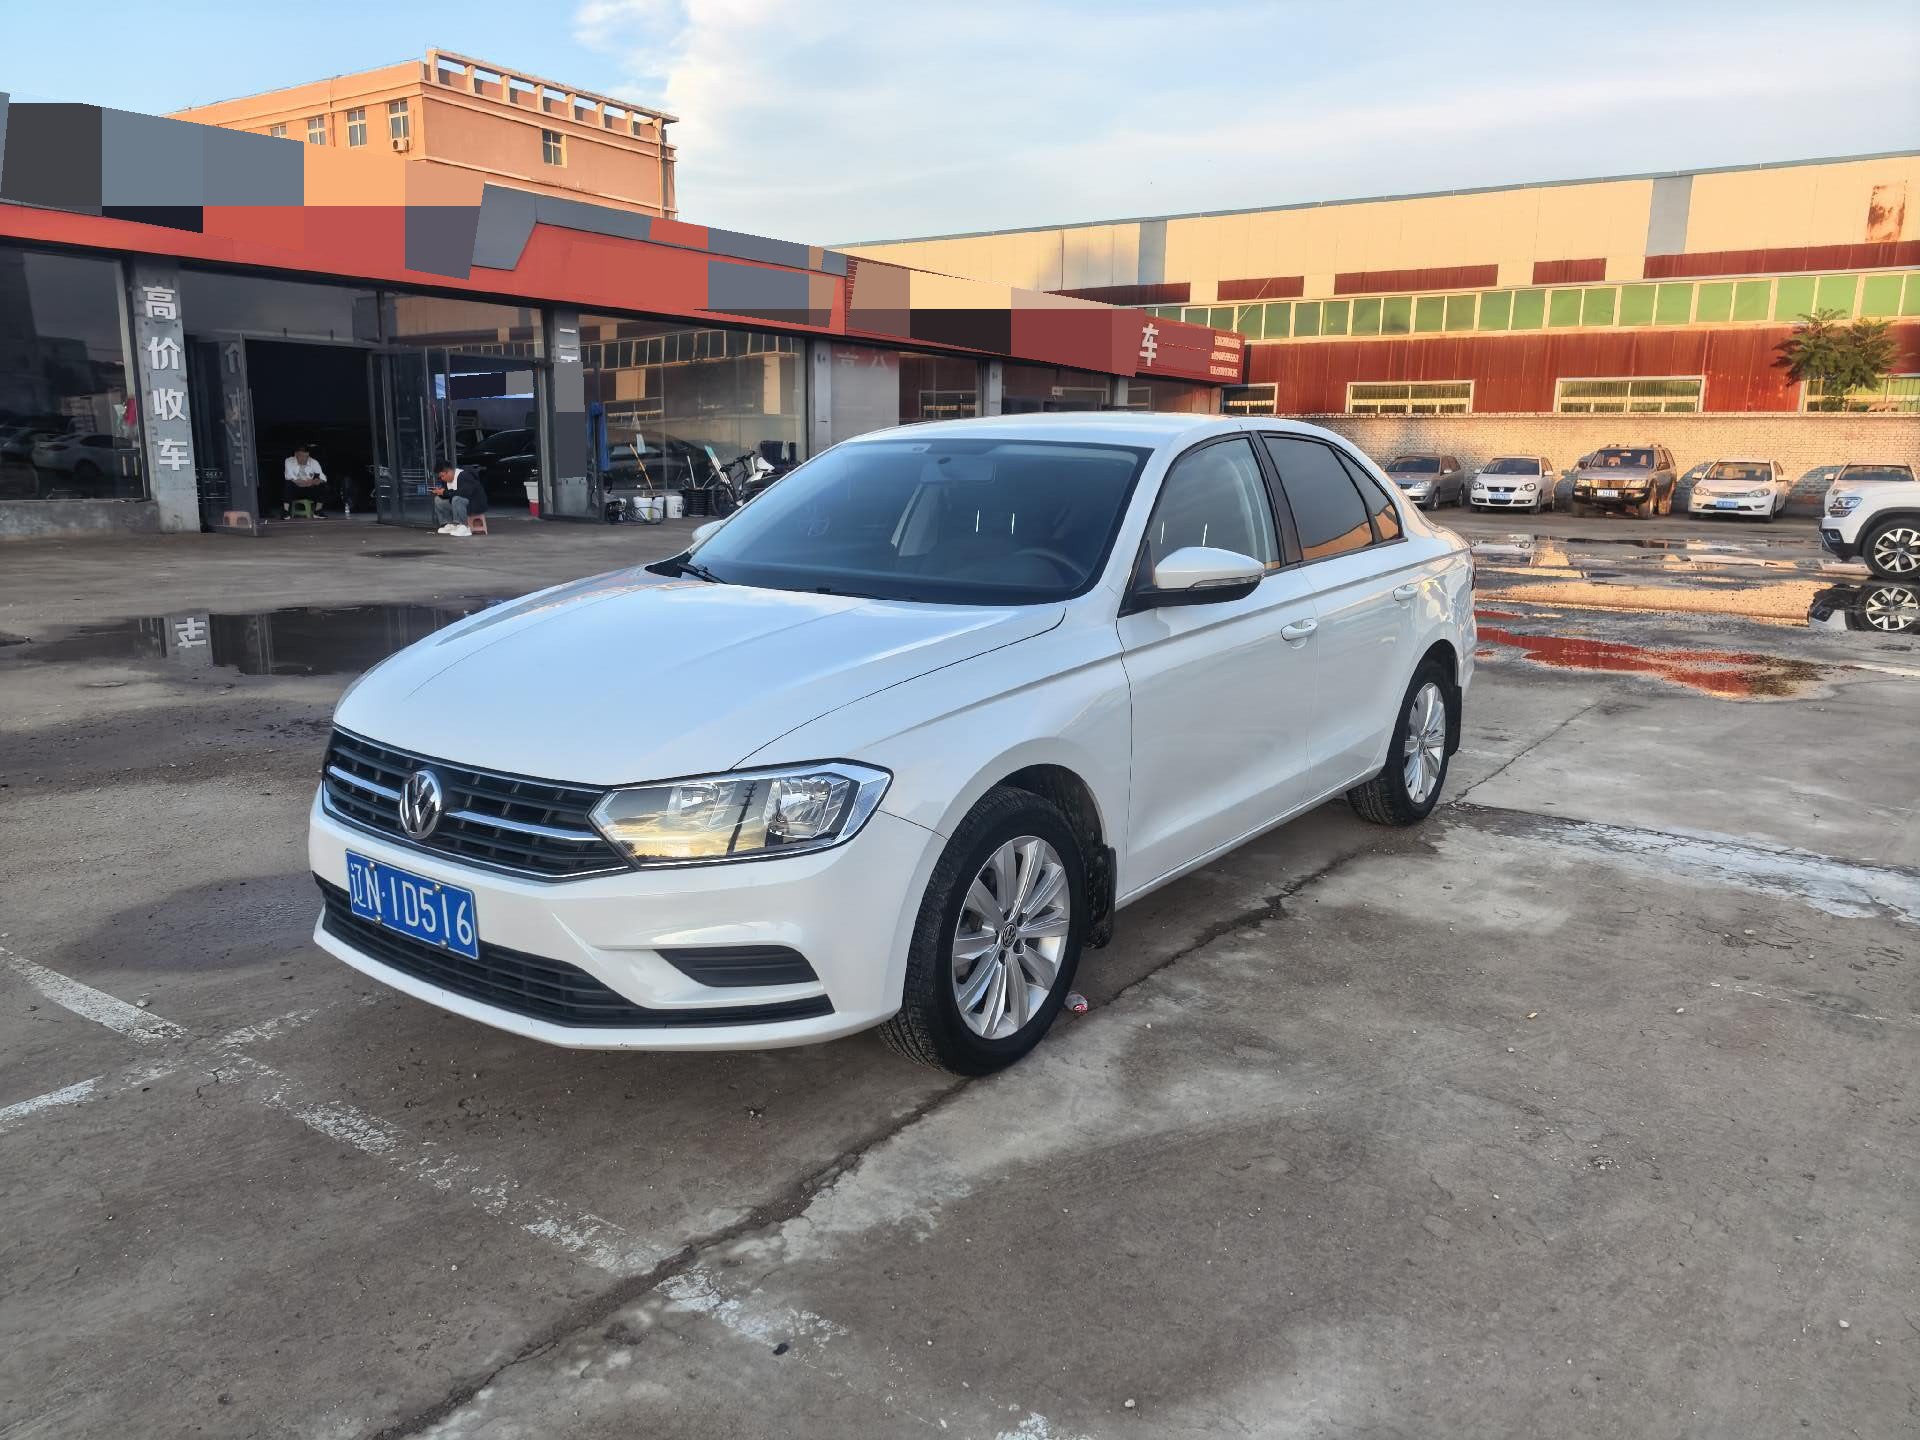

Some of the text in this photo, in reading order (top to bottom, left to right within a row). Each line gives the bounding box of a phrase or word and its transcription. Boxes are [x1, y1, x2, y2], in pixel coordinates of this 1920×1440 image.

[143, 286, 191, 471] 高价收车
[1139, 322, 1160, 367] 车
